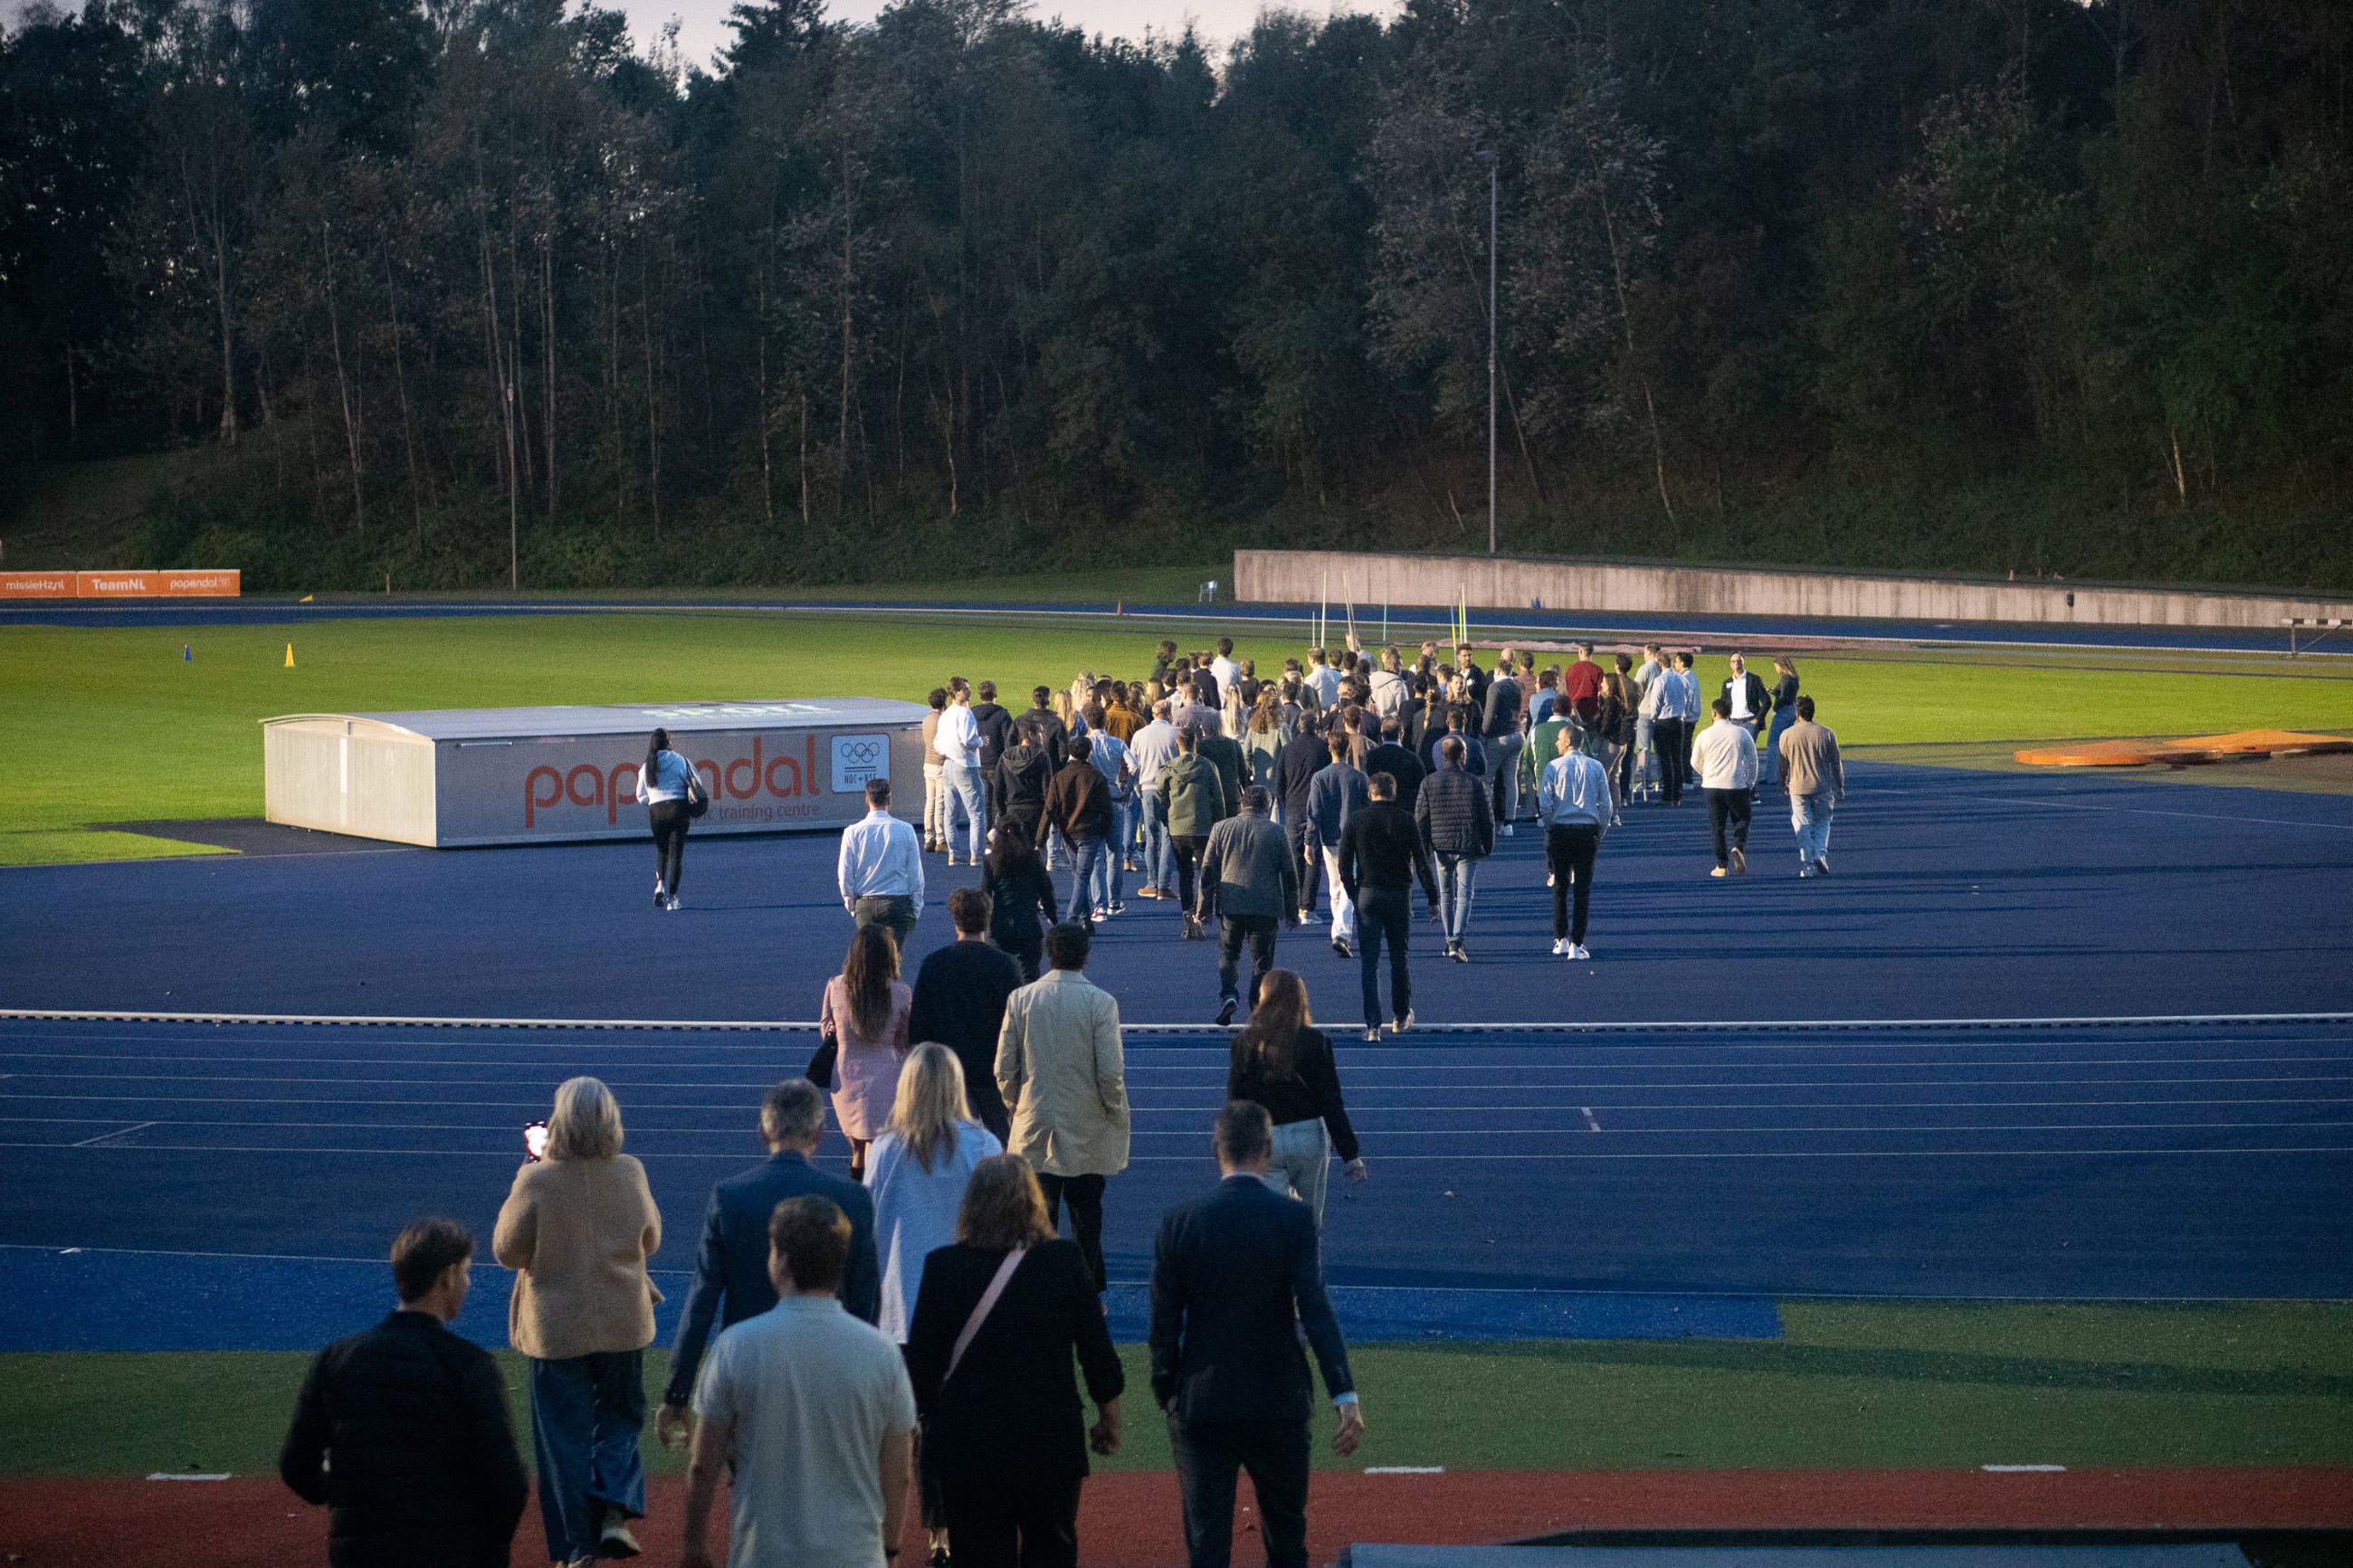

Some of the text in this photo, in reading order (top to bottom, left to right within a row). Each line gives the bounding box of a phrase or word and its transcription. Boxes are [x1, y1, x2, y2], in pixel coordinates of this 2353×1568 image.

[92, 578, 145, 592] TeamNL
[170, 576, 217, 591] papendal
[525, 734, 821, 829] papndal
[719, 803, 773, 822] training
[776, 803, 821, 818] centre
